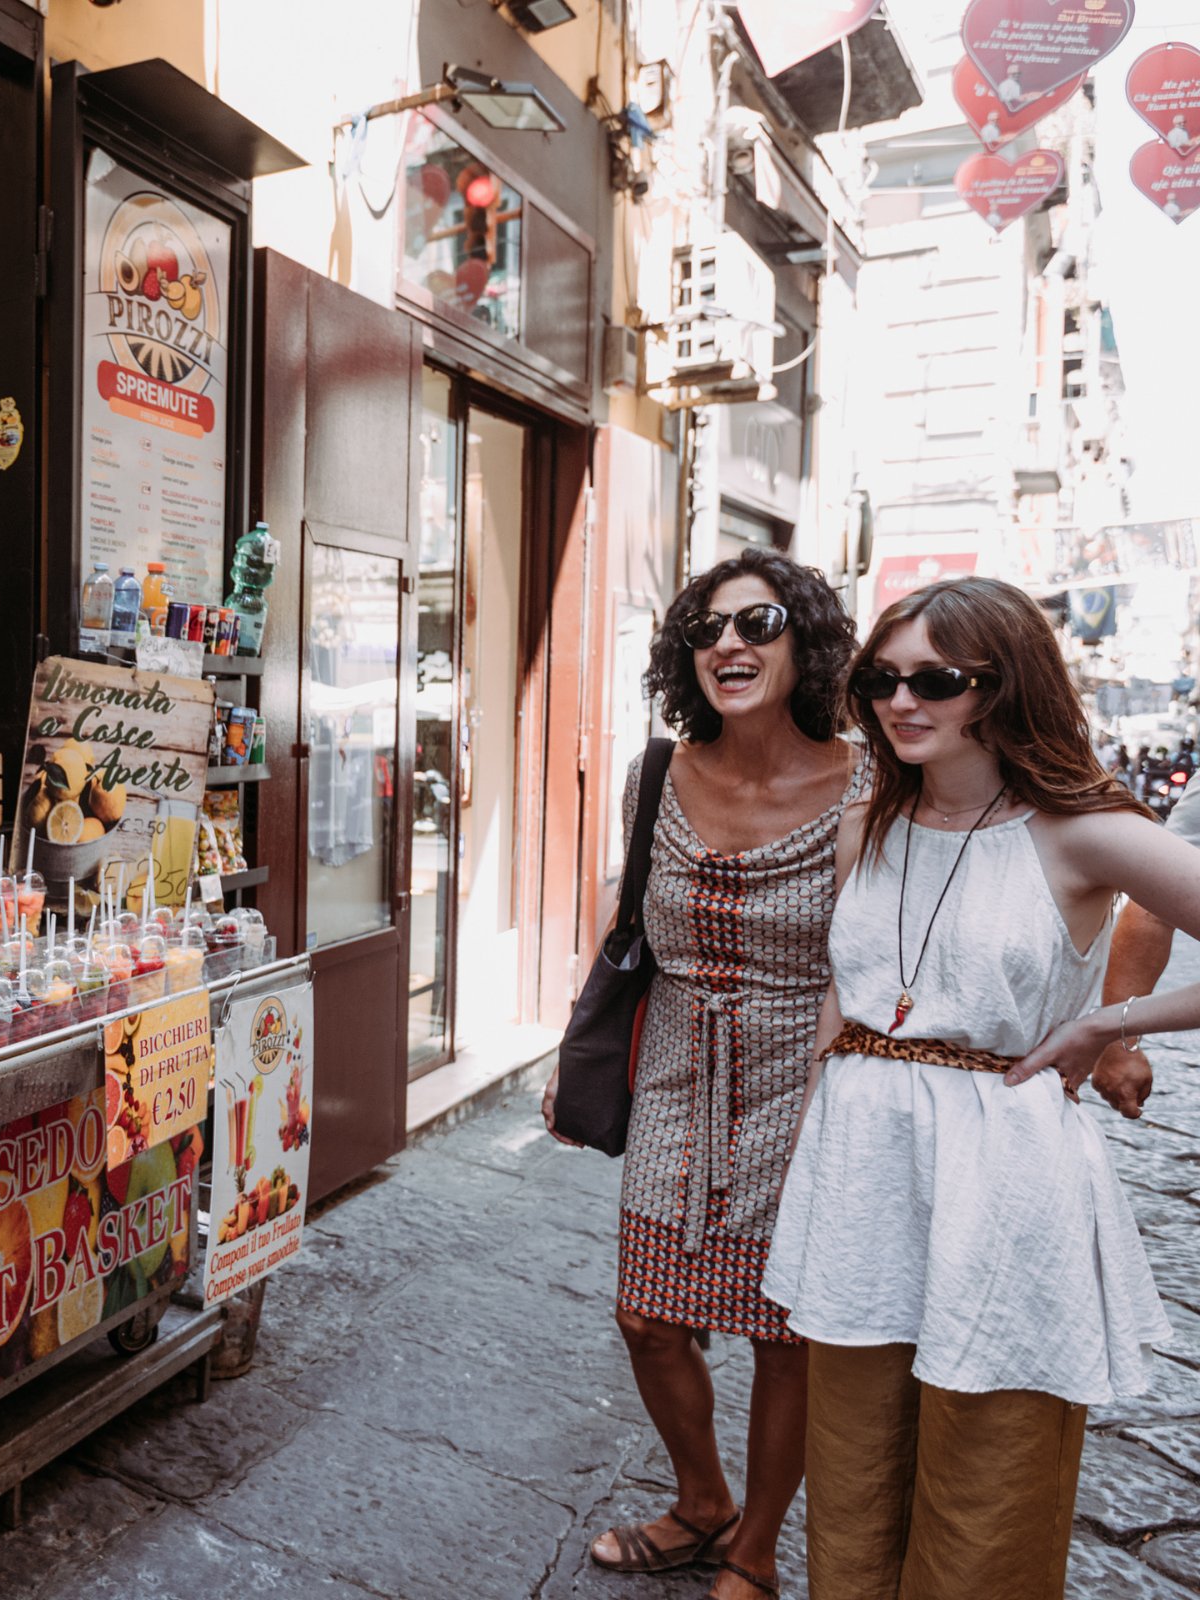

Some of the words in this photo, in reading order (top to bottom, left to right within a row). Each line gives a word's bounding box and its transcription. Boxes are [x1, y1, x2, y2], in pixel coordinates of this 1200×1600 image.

[107, 294, 215, 367] PIROZZI
[116, 371, 199, 420] SPREMUTE
[43, 663, 176, 716] Limonata
[37, 715, 65, 737] a
[71, 705, 156, 750] Cosce
[85, 746, 193, 793] Aperte
[139, 1016, 208, 1058] BICCHIERI
[252, 1034, 286, 1057] PIROZZI
[139, 1065, 154, 1087] DI
[158, 1045, 209, 1080] FRUTTA
[153, 1091, 162, 1126] €
[164, 1076, 196, 1123] 2,50
[30, 1178, 192, 1316] BASKET
[207, 1267, 246, 1301] Compose
[248, 1257, 266, 1287] your
[267, 1235, 300, 1268] smoothie
[211, 1238, 249, 1275] Componi
[251, 1231, 257, 1254] il
[258, 1231, 271, 1250] tuo
[272, 1214, 302, 1242] Frullato
